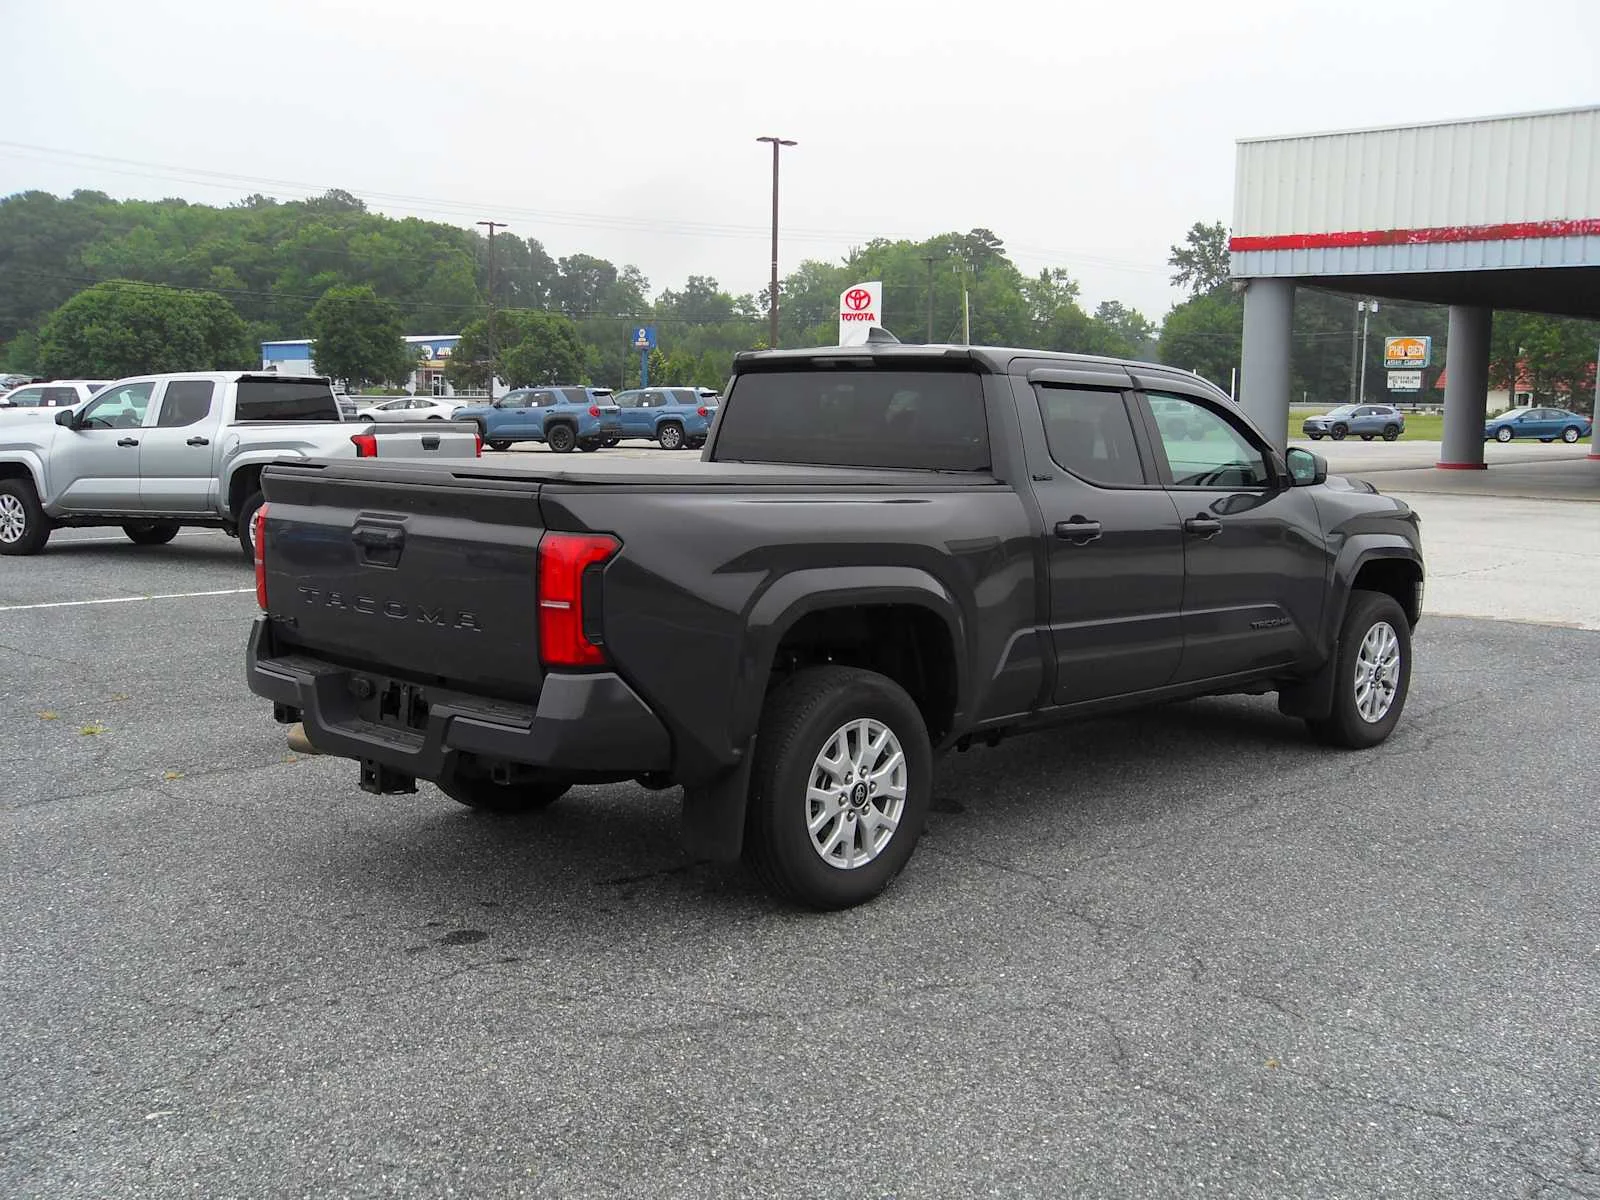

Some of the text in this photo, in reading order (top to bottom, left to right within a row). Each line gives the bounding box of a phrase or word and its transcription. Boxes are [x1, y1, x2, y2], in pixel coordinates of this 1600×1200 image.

[841, 313, 875, 321] TOYOTA
[1388, 345, 1405, 357] PHO
[297, 586, 483, 633] TACOMA
[1250, 616, 1292, 630] TACOMA
